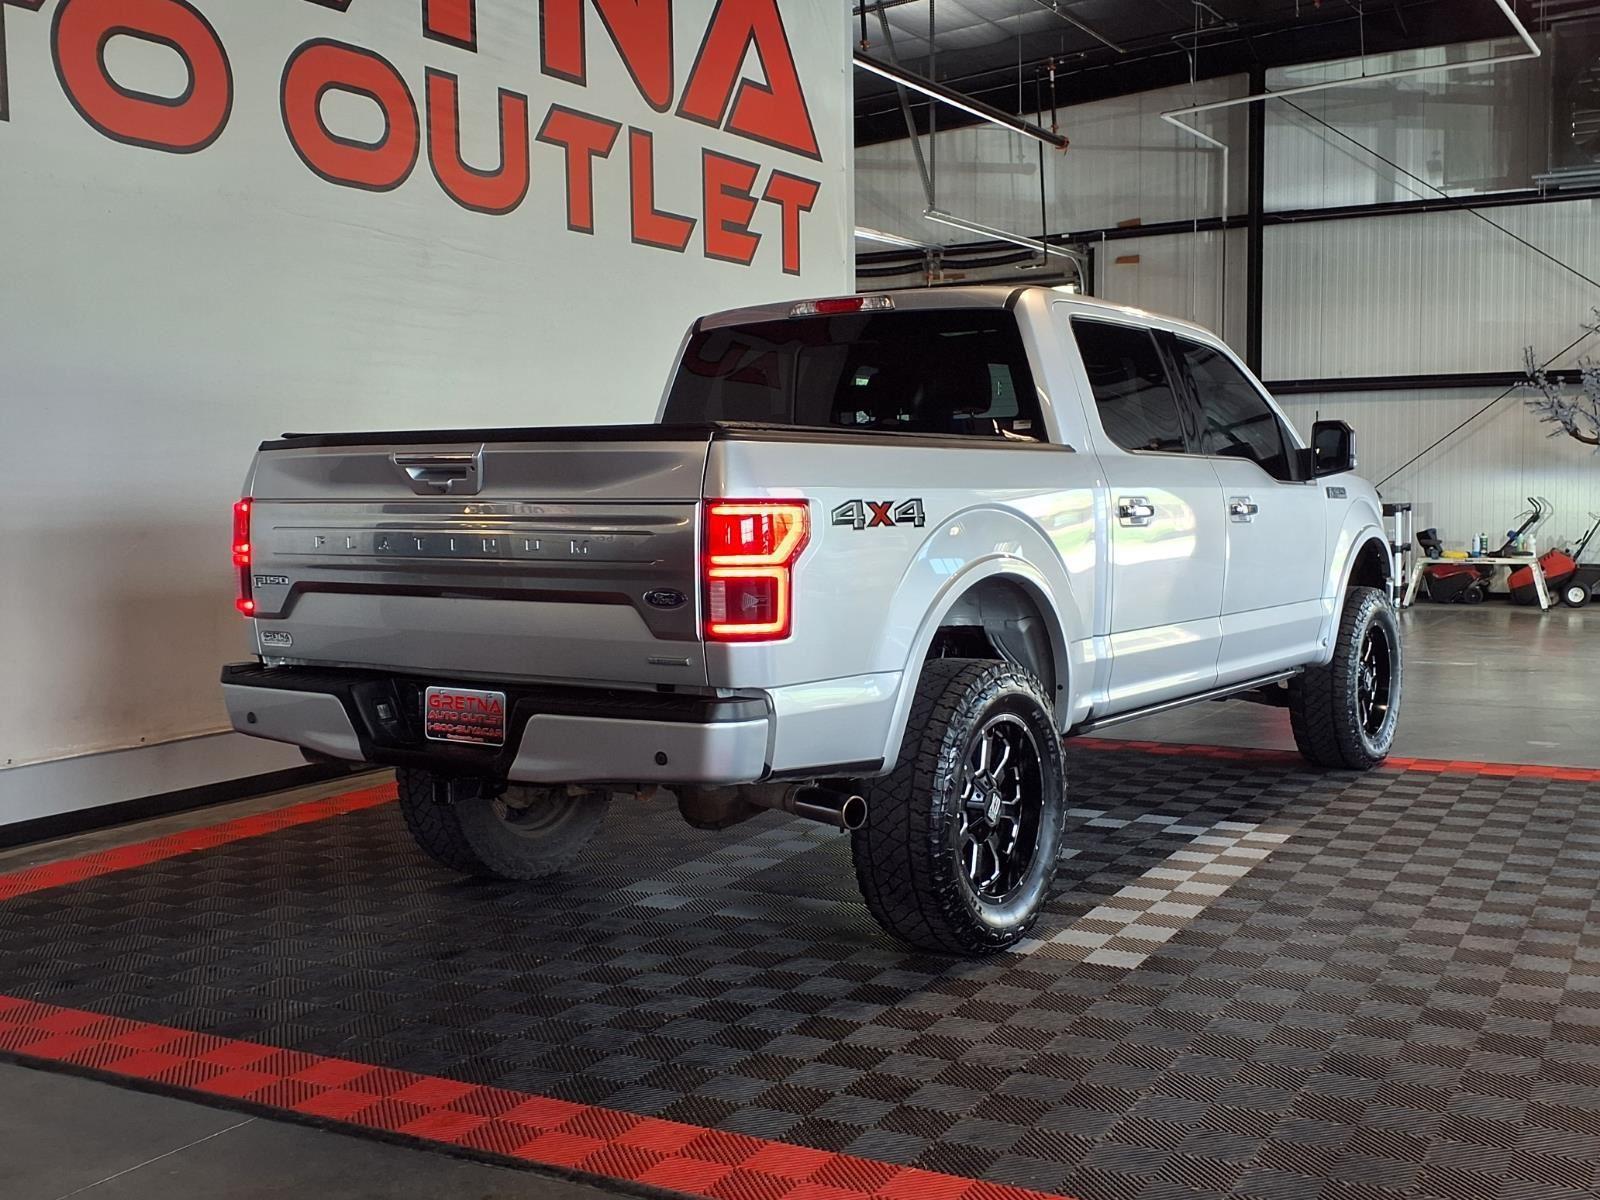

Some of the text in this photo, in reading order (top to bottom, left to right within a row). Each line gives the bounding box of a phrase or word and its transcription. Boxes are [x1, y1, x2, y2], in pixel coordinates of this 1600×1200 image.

[279, 37, 822, 276] OUTLET
[313, 535, 589, 555] PLATINUM
[429, 693, 502, 714] GRETNA
[427, 709, 503, 725] AUTO OUTLET
